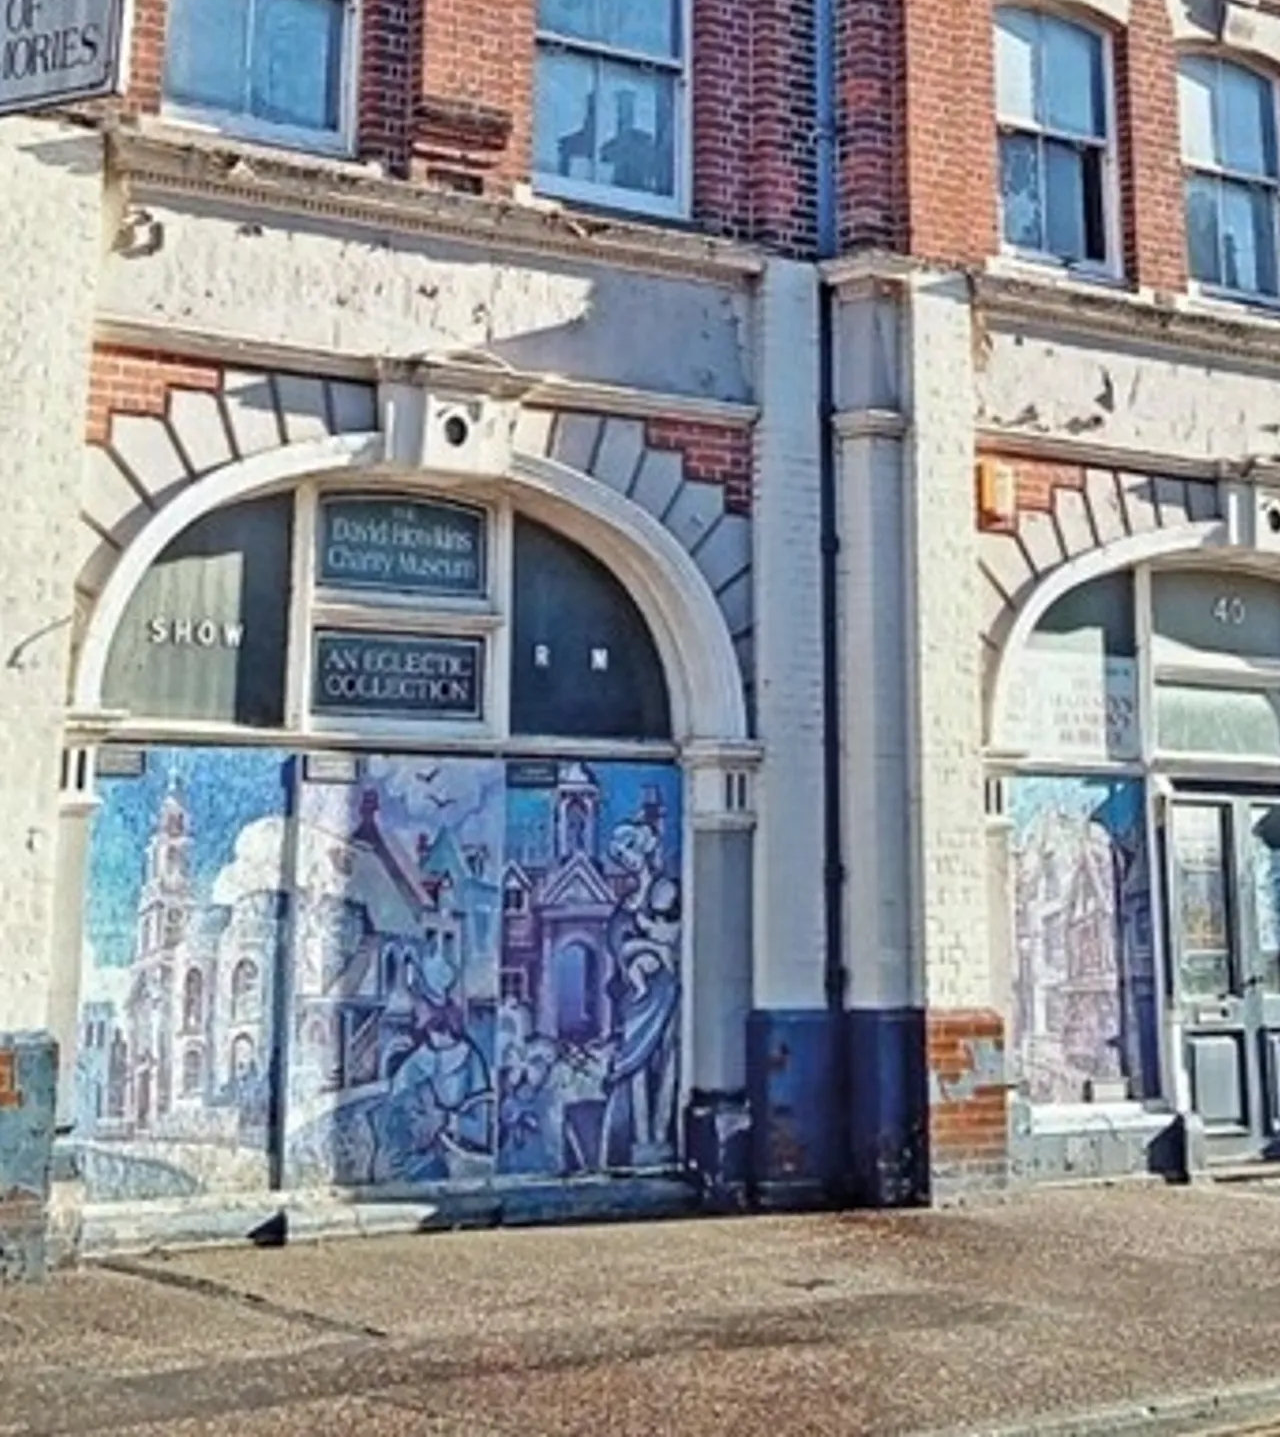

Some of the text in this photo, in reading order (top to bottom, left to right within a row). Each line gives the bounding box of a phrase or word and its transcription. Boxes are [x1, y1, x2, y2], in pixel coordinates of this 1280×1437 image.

[332, 517, 389, 546] David
[399, 551, 477, 581] Museum
[1213, 596, 1246, 625] 40
[151, 615, 244, 649] SHOW
[323, 648, 472, 677] AN ECLECTIC
[324, 673, 470, 702] COLLECTION
